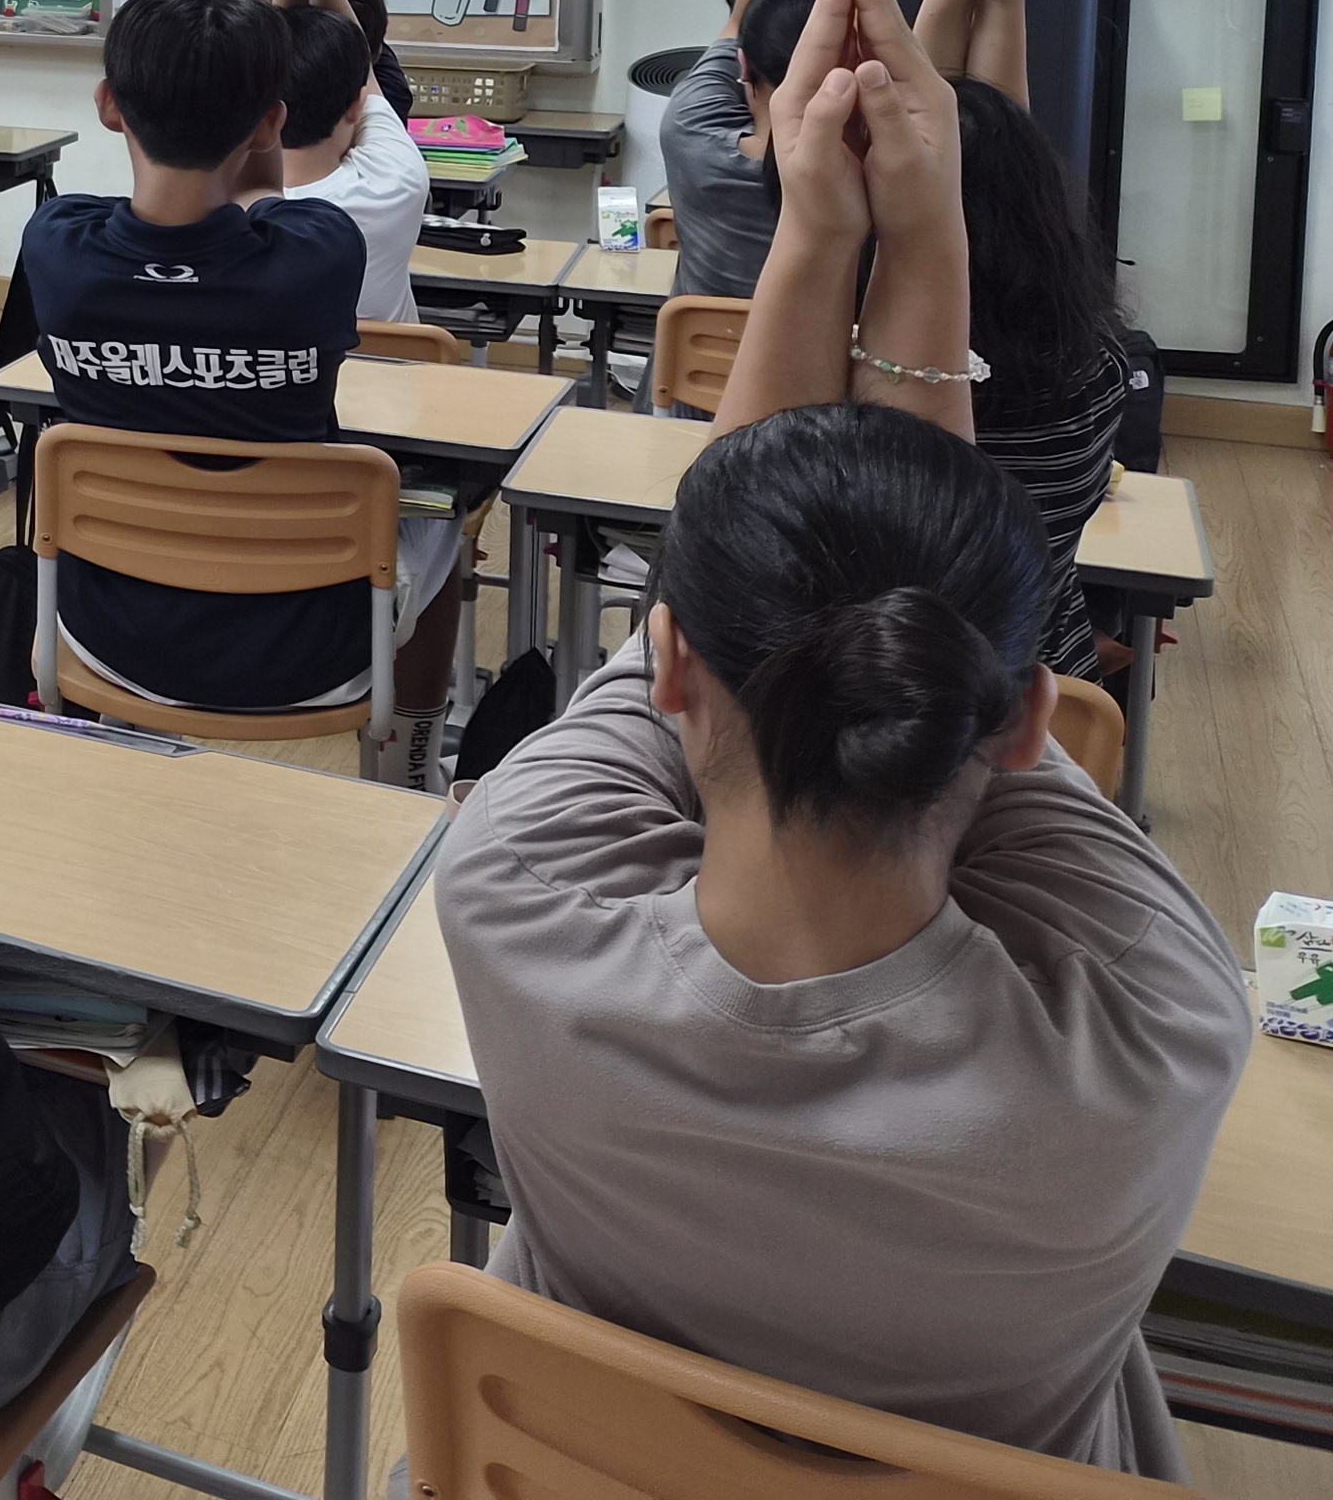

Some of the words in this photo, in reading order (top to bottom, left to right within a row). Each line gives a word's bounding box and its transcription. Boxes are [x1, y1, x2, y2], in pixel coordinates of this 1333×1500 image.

[47, 333, 318, 389] 제주올레스포츠클럽
[408, 720, 433, 772] ORENDA
[1297, 951, 1321, 966] 우유
